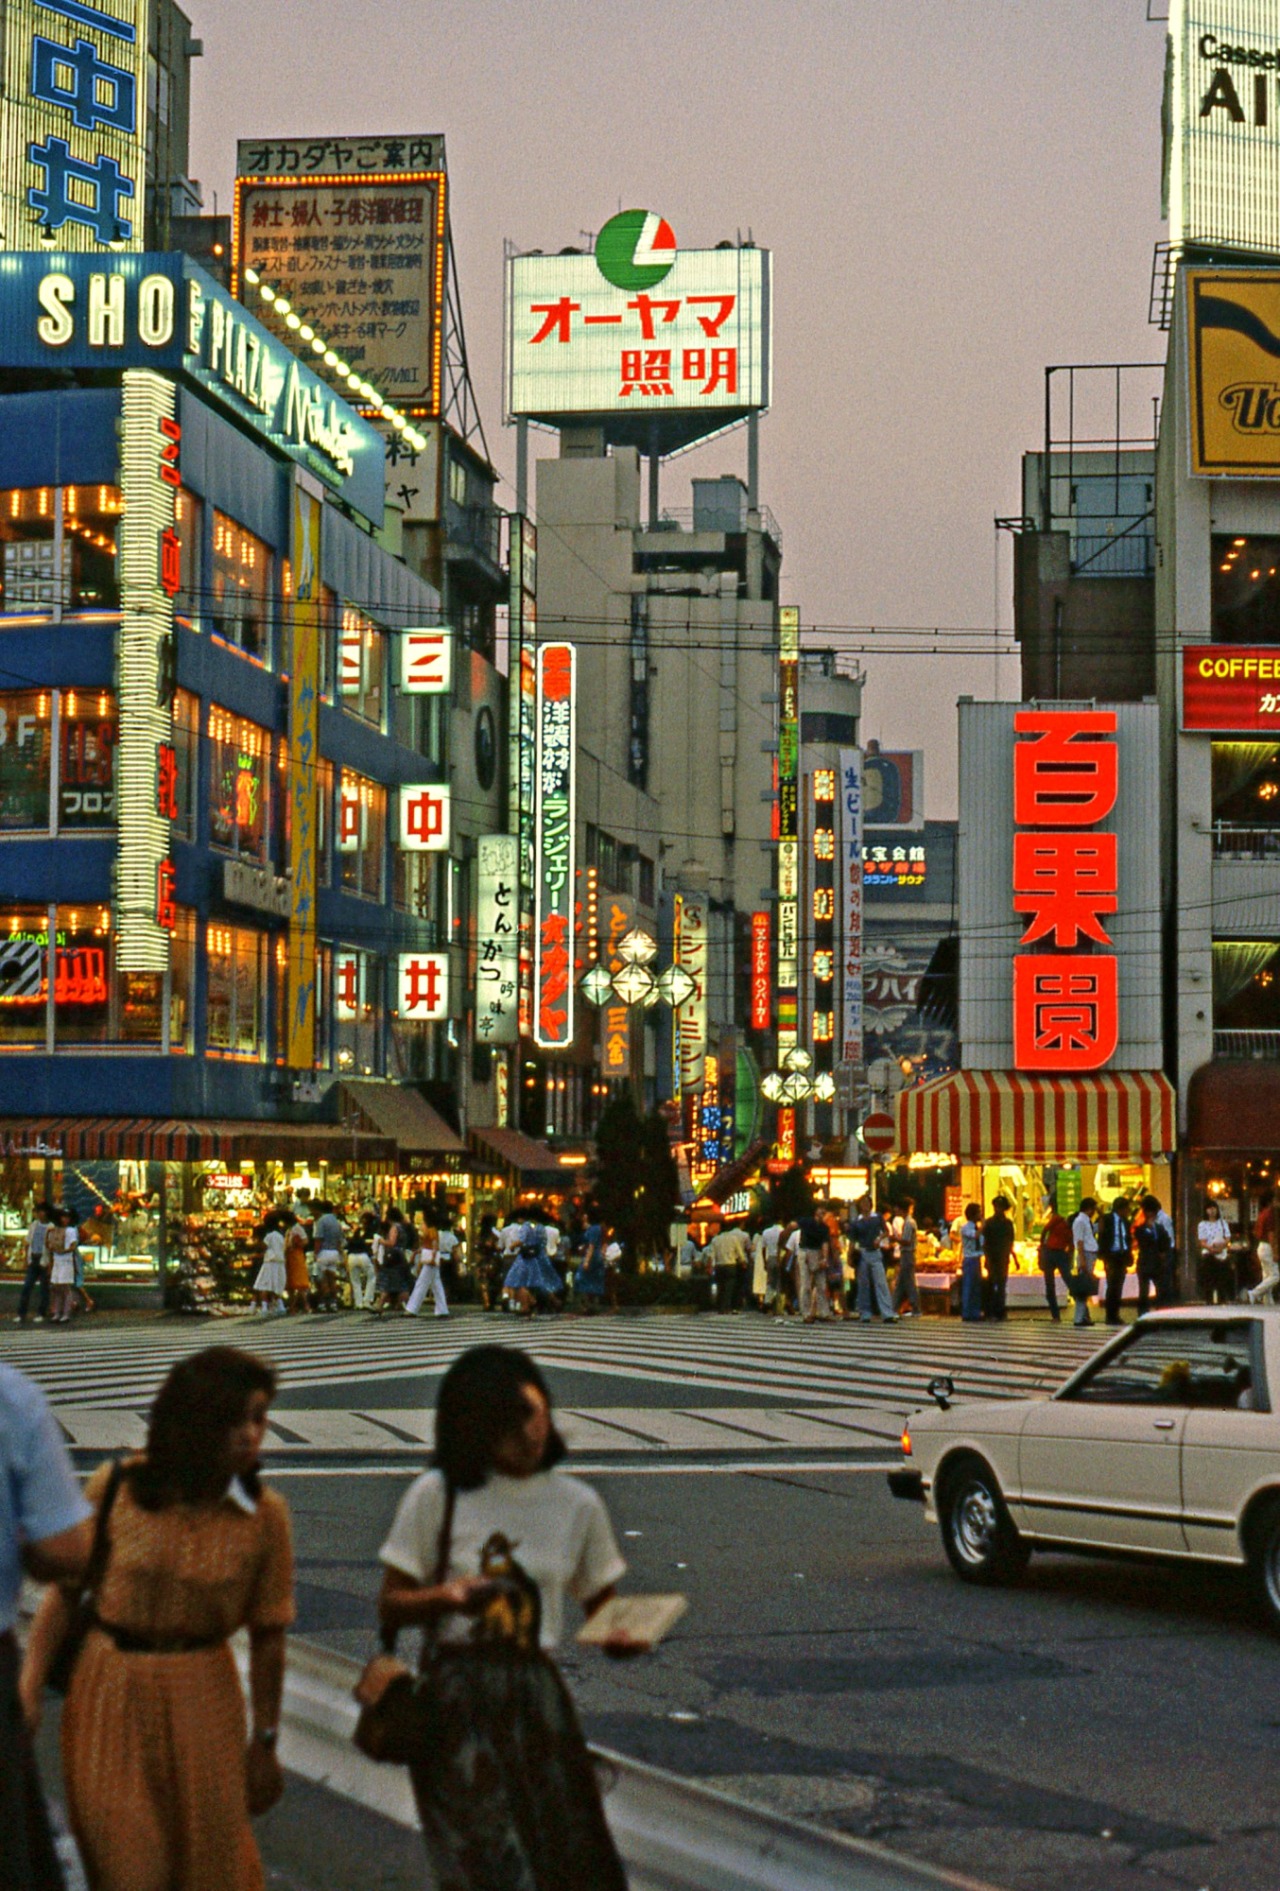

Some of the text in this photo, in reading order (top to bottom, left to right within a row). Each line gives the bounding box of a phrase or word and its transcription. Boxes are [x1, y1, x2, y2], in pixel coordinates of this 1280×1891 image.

[1199, 67, 1280, 127] AI
[248, 140, 434, 172] オカダヤご案内
[528, 294, 736, 344] オーヤマ
[618, 347, 737, 397] 照明
[1014, 711, 1118, 1070] 百果園
[8, 930, 66, 947] Minaai
[479, 882, 514, 981] とんかつ
[756, 978, 769, 1024] ハンバーガー
